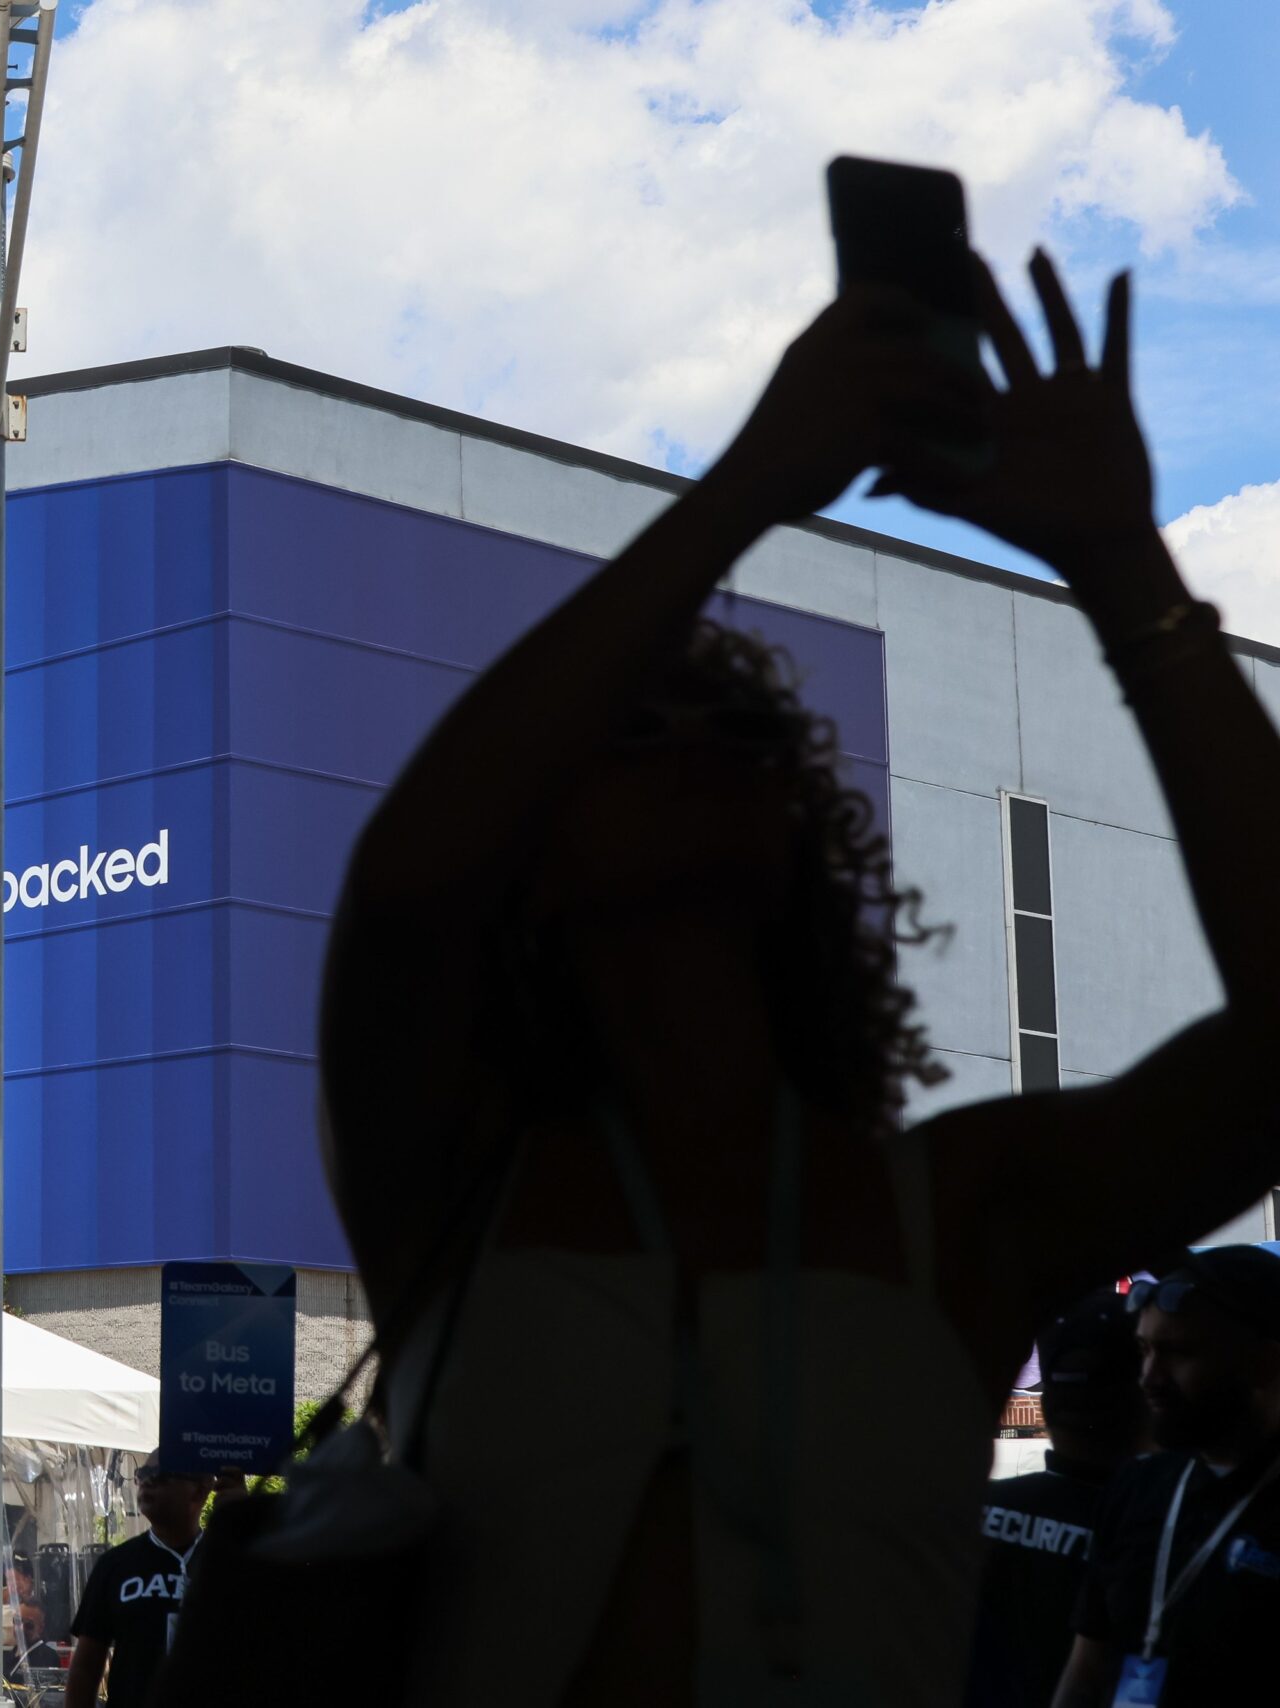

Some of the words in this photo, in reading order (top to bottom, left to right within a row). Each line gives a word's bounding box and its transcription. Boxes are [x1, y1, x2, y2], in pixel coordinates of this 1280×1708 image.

[169, 1281, 254, 1296] #TeamGalaxy
[206, 1340, 251, 1363] Bus
[179, 1371, 206, 1393] to
[211, 1372, 277, 1396] Meta
[181, 1431, 272, 1448] #TeamGalaxy
[199, 1447, 255, 1461] Connect
